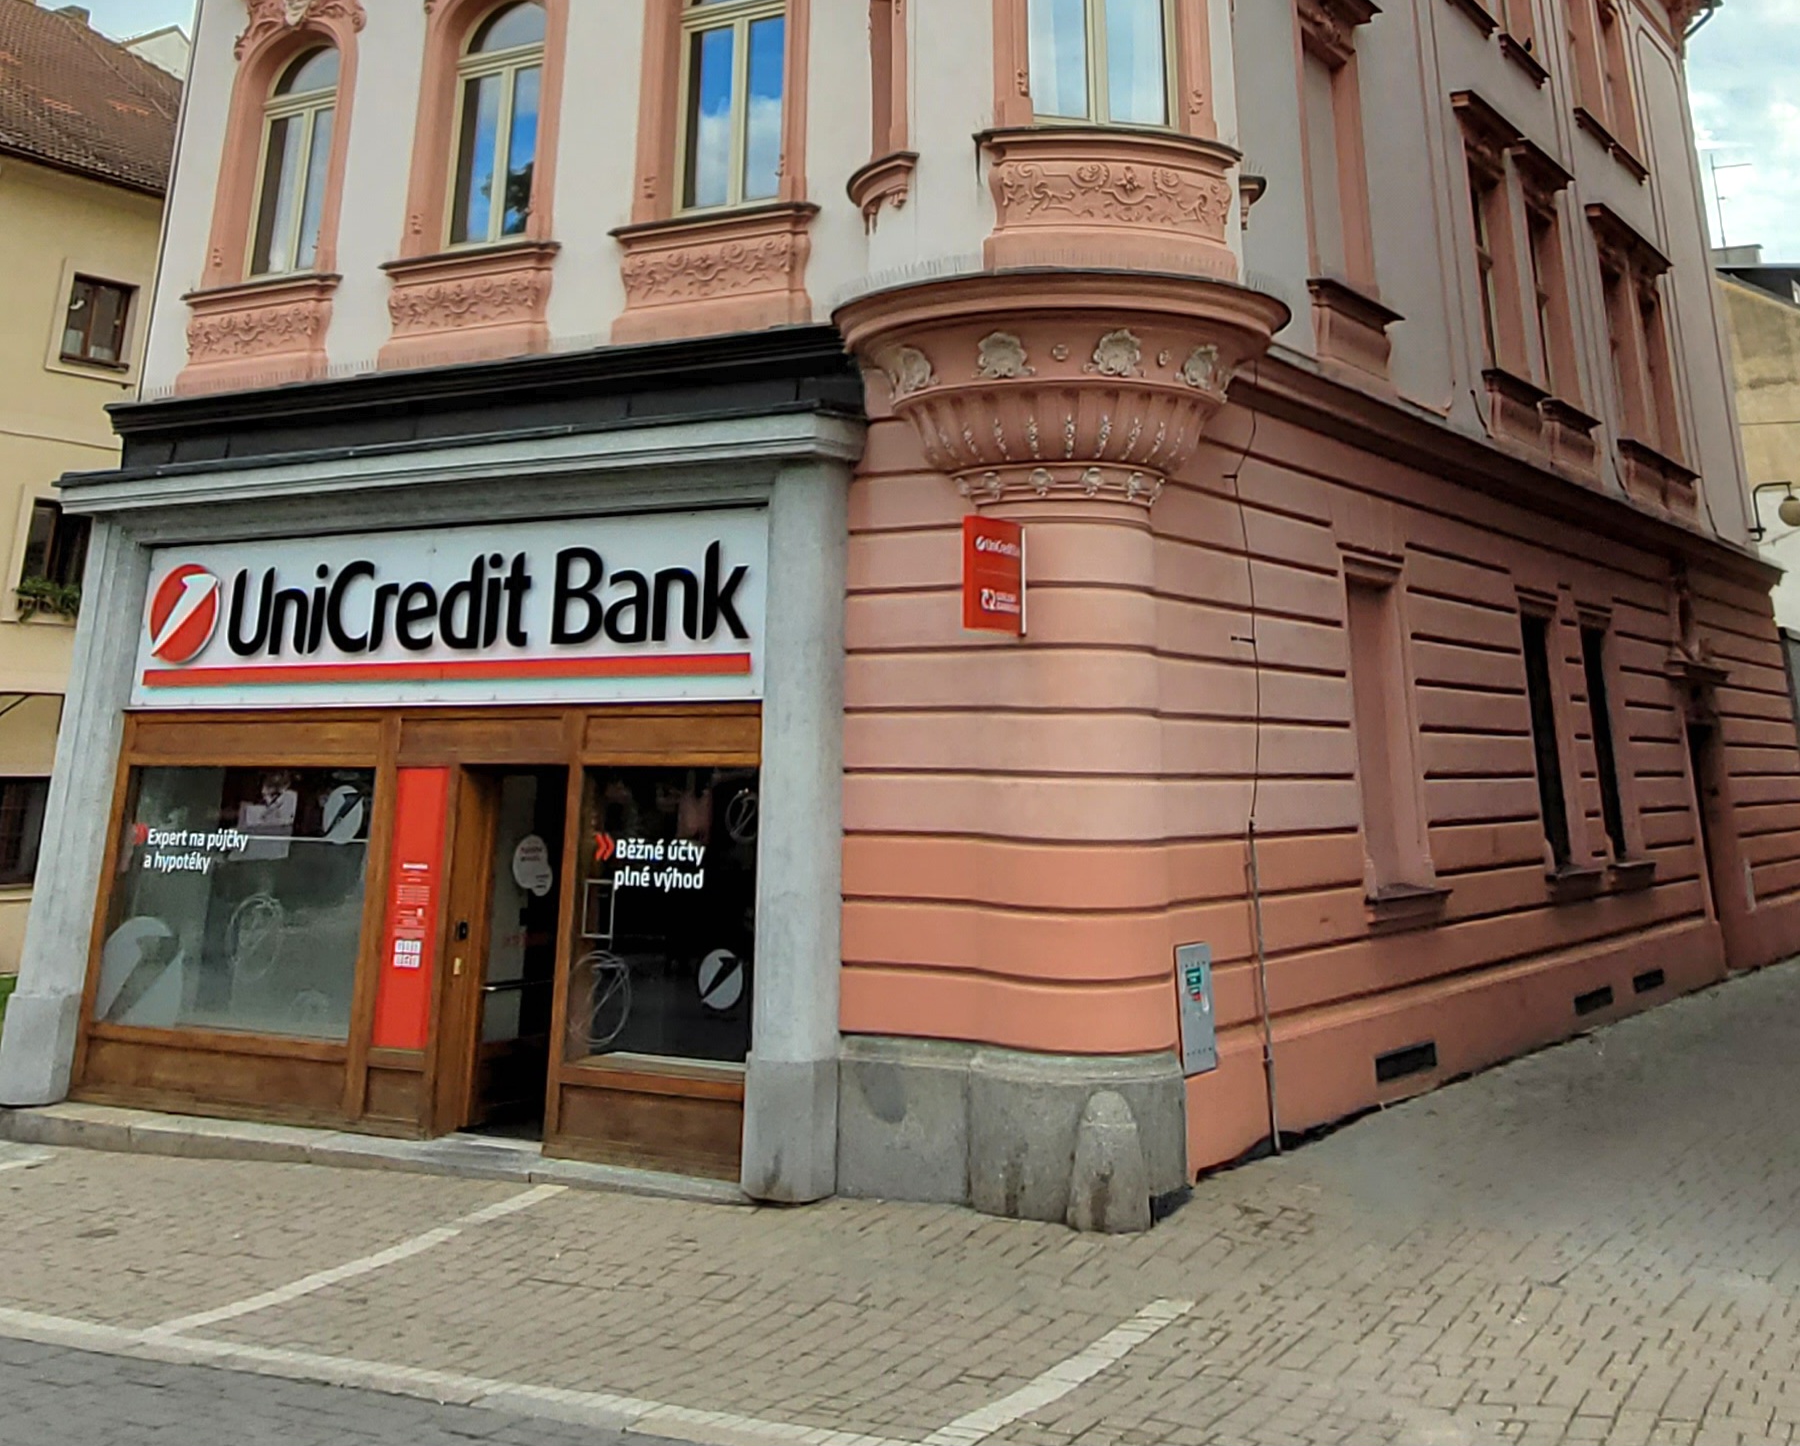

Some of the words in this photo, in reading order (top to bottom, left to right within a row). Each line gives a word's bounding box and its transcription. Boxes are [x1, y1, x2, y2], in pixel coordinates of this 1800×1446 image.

[227, 552, 532, 656] UniCredit
[550, 539, 750, 645] Bank
[147, 828, 187, 849] Expert
[189, 833, 205, 846] na
[206, 828, 248, 852] půjčky
[615, 838, 664, 860] Běžné
[667, 839, 705, 867] účty
[143, 854, 152, 869] a
[153, 851, 211, 874] hypotéky
[614, 865, 650, 890] plné
[653, 866, 704, 892] výhod
